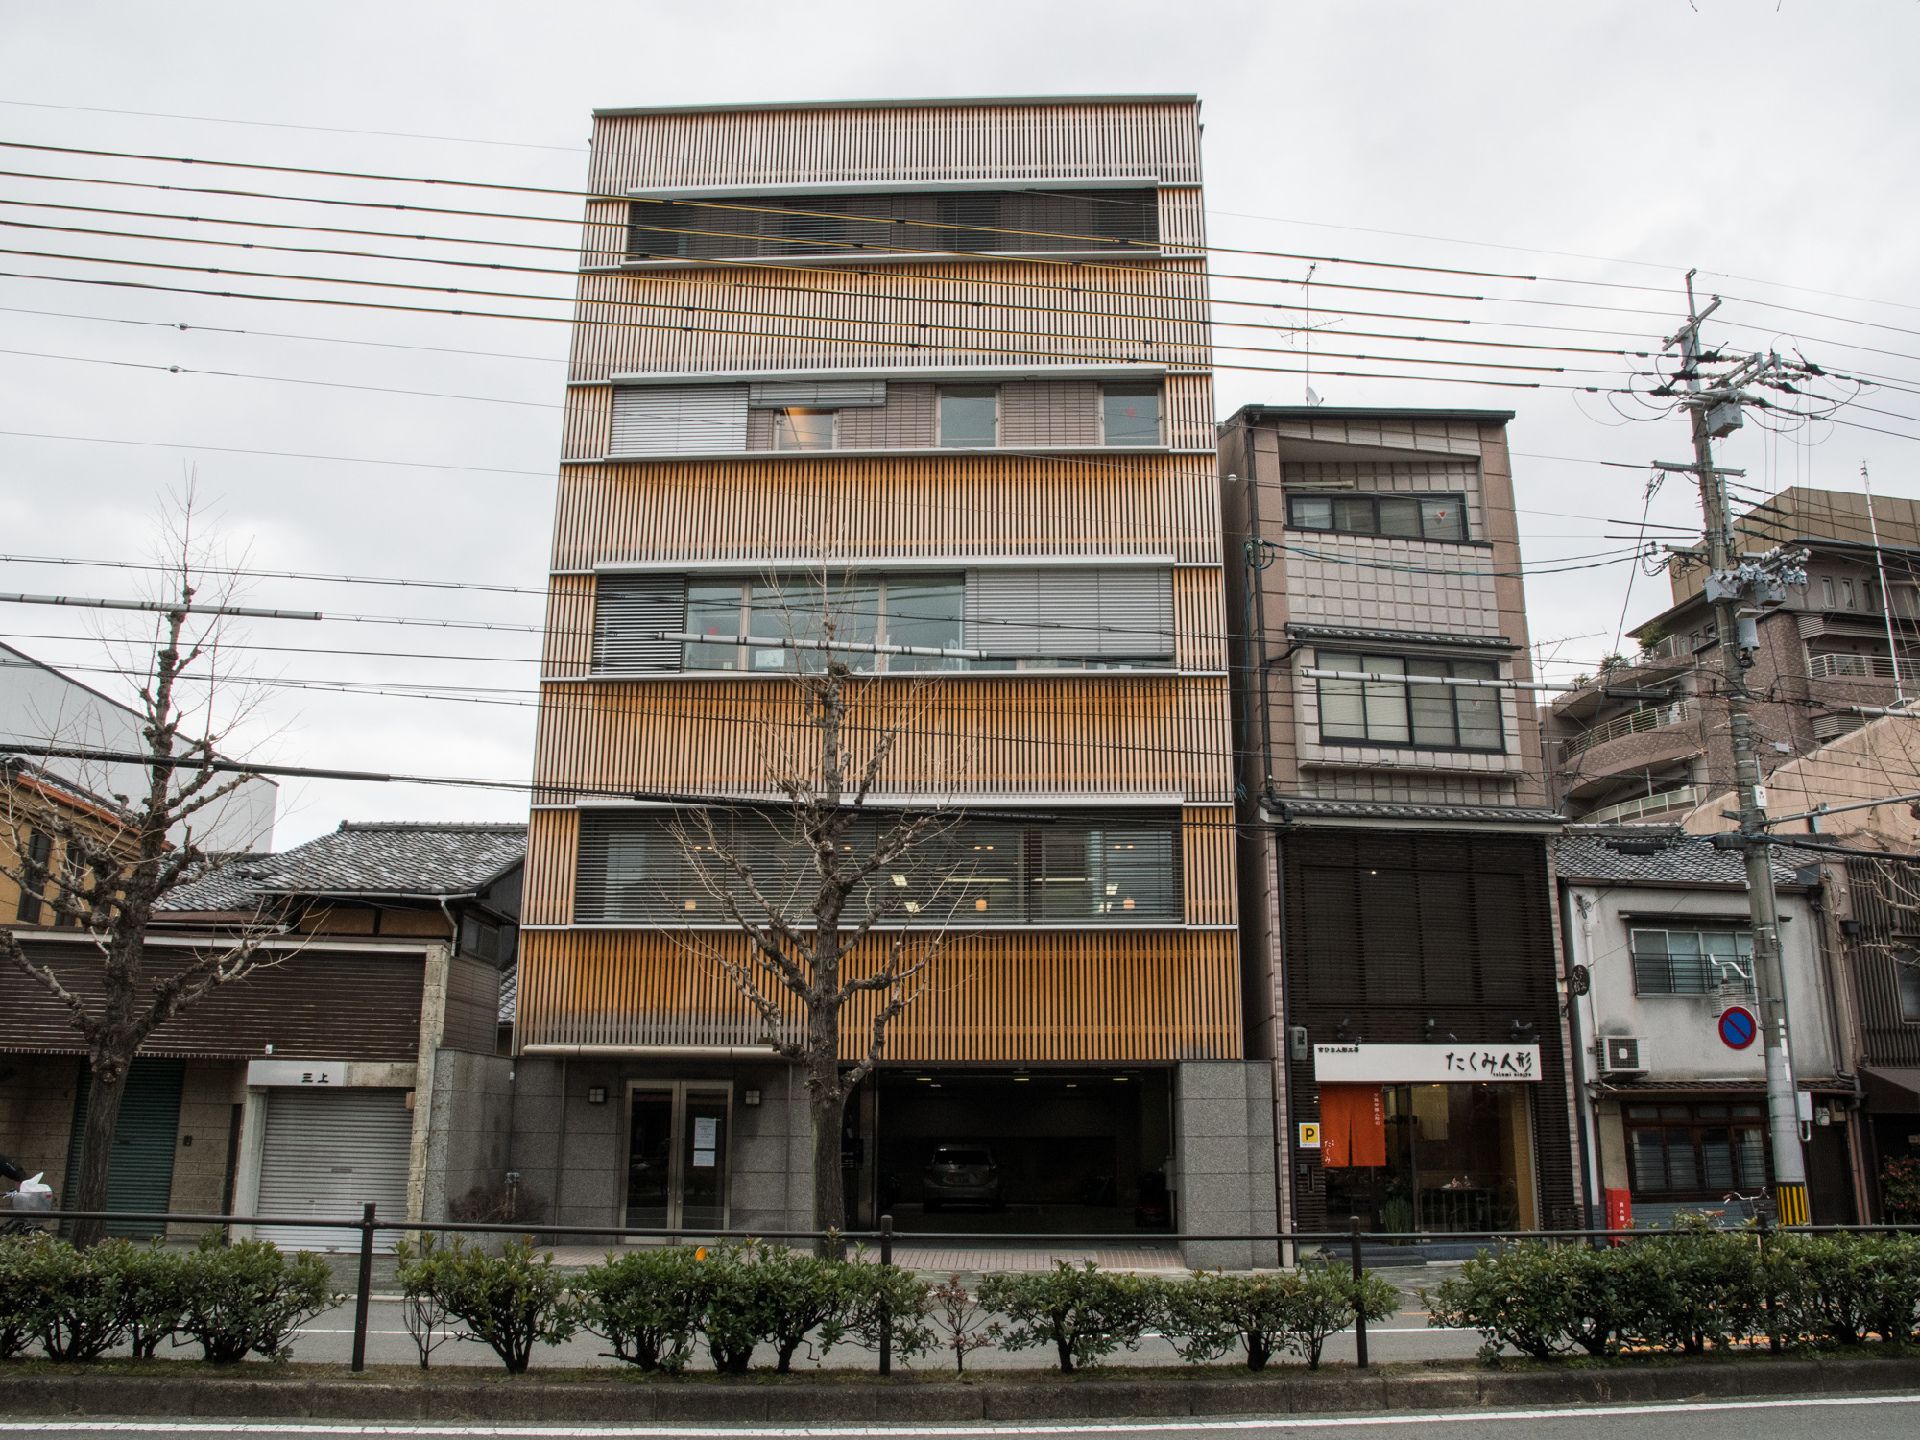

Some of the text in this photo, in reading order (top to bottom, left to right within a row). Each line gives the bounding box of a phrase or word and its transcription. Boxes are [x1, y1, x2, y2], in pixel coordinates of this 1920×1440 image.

[1445, 1051, 1533, 1074] たくみ人形
[301, 1072, 329, 1084] 三上
[1305, 1127, 1315, 1141] P
